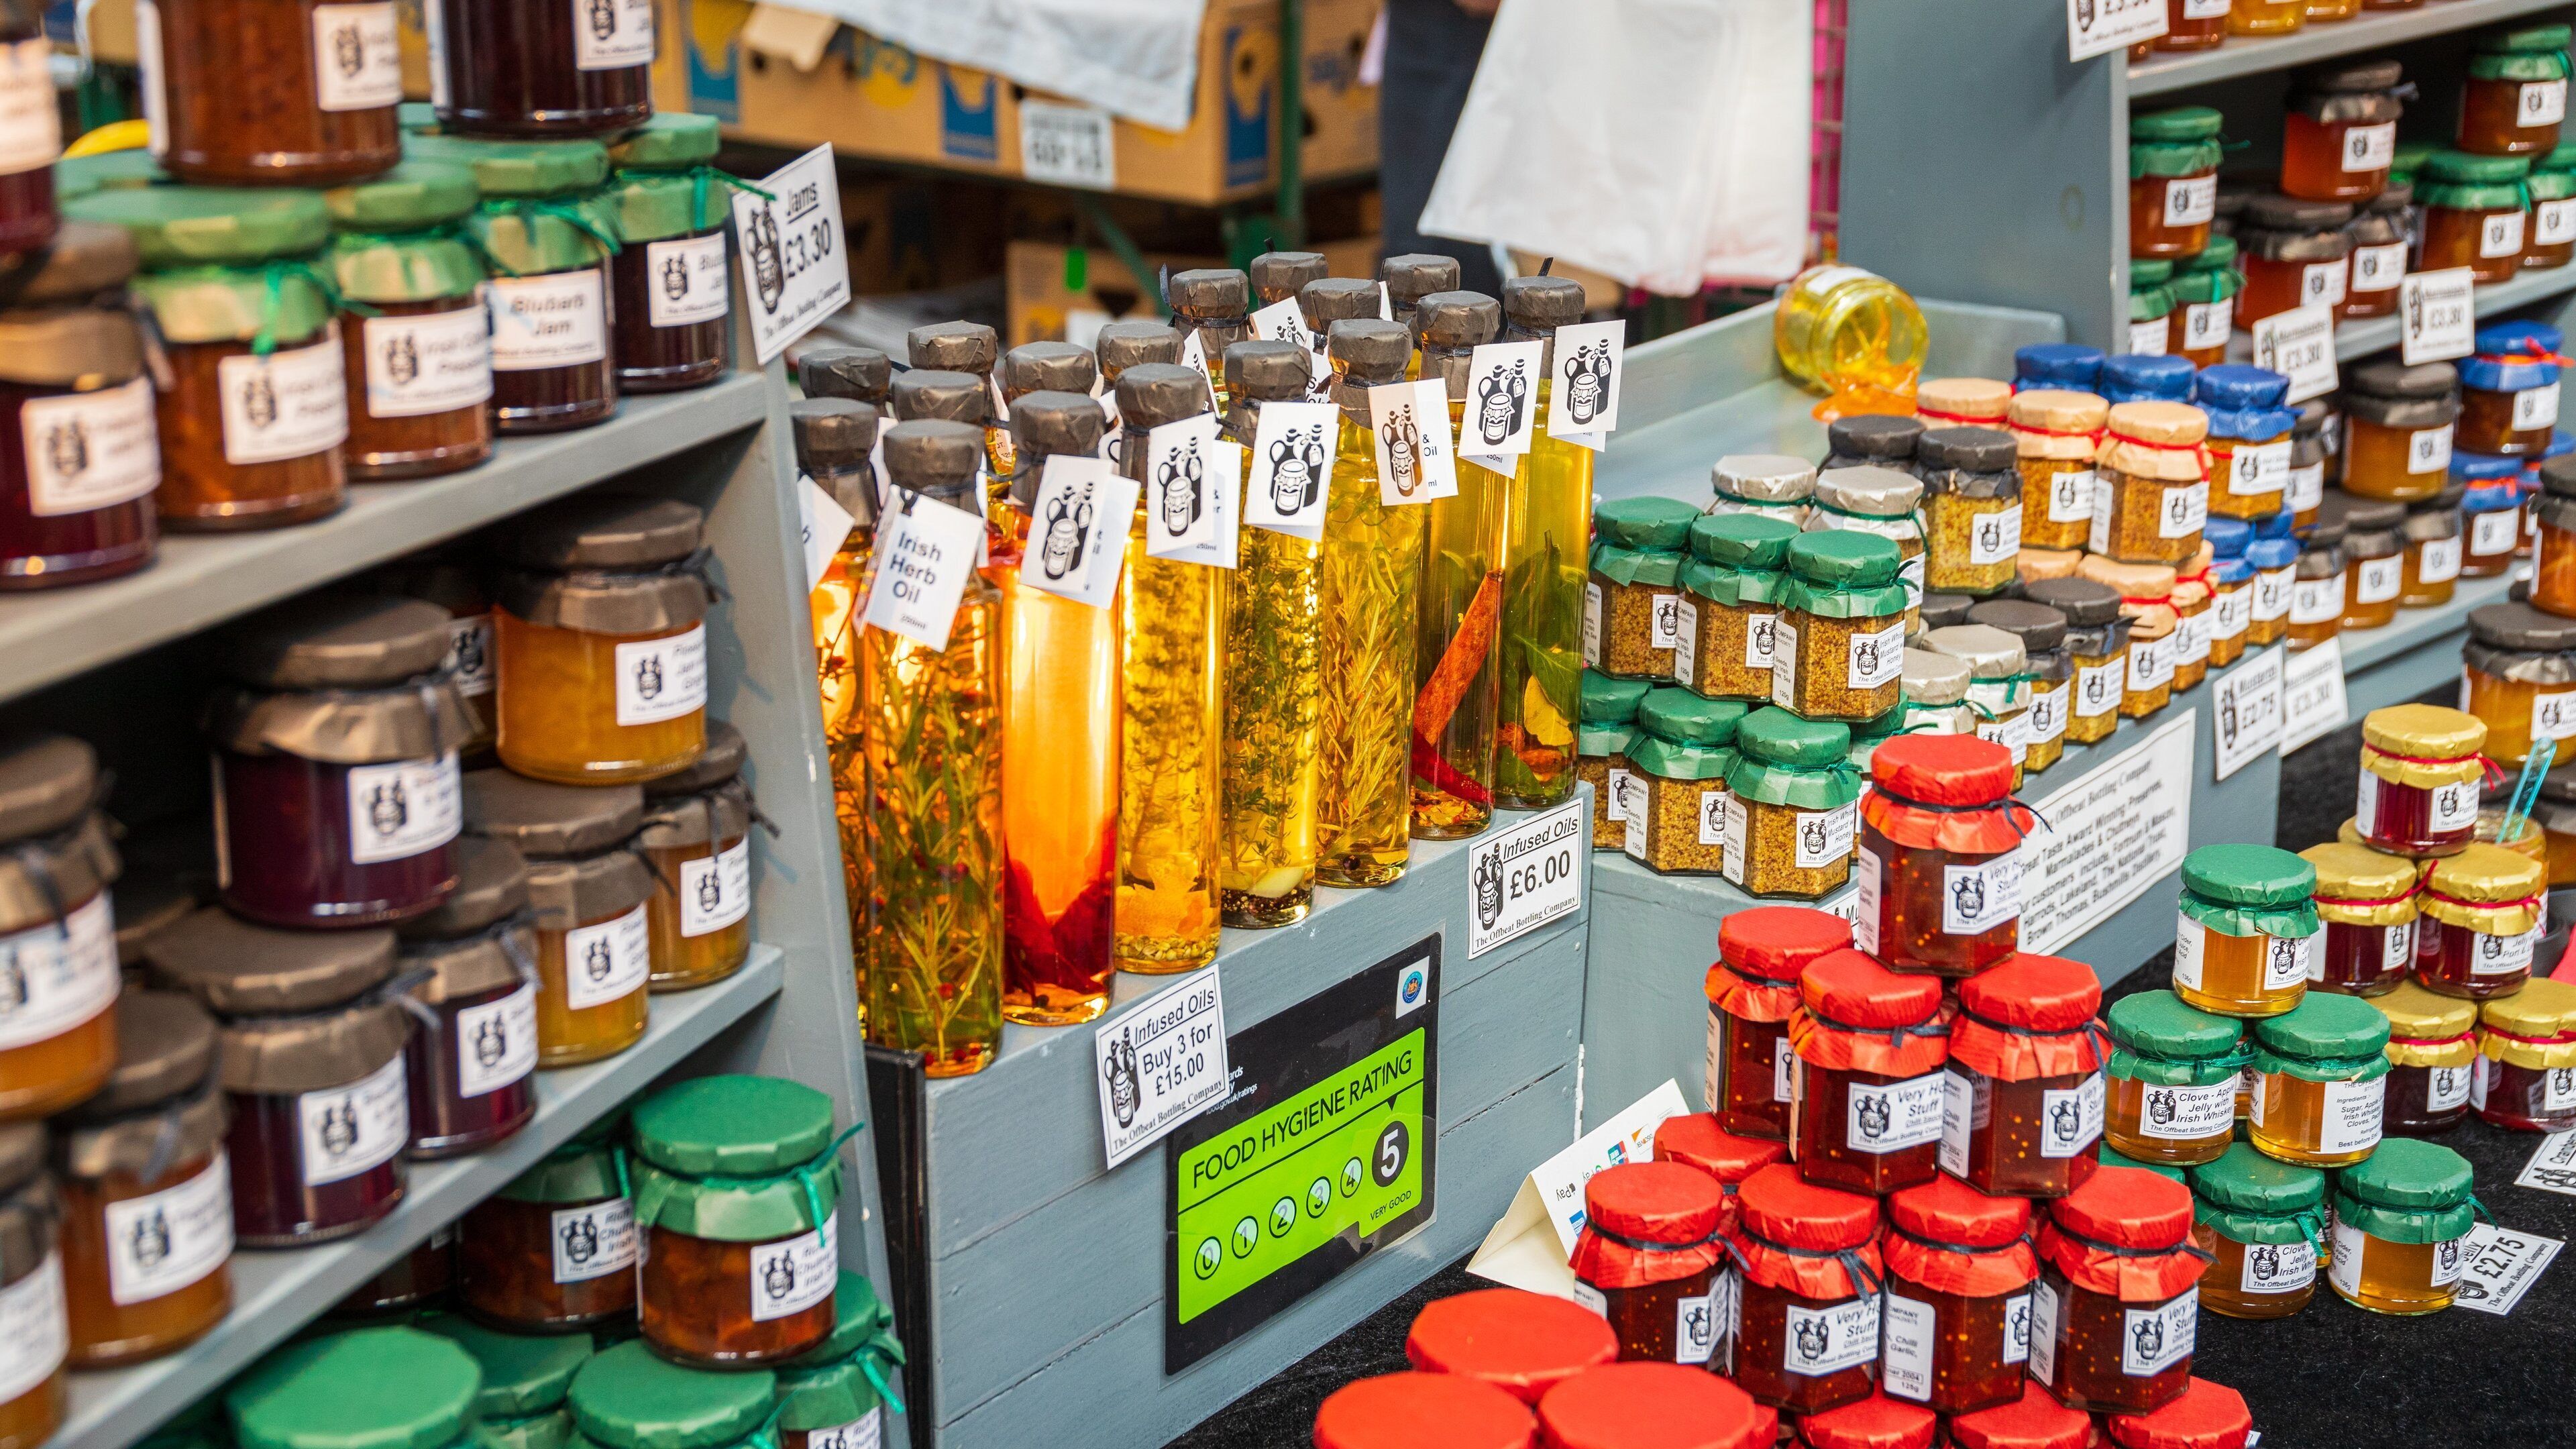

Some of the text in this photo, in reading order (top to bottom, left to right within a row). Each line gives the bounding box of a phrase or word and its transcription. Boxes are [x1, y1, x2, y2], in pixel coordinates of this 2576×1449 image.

[786, 182, 818, 217] Jams
[786, 217, 832, 279] £3.30
[533, 319, 572, 335] Jam
[1422, 433, 1430, 444] &
[897, 529, 943, 562] Irish
[889, 553, 938, 585] Herb
[892, 580, 922, 604] Oil
[1886, 653, 1902, 666] Honey
[1778, 688, 1790, 702] 120g
[1726, 805, 1746, 820] COMPANY
[1826, 816, 1839, 828] Irish
[1827, 821, 1849, 838] Mustard
[1503, 816, 1578, 860] Infused Oils
[1835, 831, 1853, 844] Honey
[2041, 838, 2063, 862] Taste
[2066, 822, 2093, 849] Award
[1631, 841, 1643, 853] 120g
[1509, 849, 1571, 902] £6.00
[1729, 867, 1740, 879] 120g
[2032, 873, 2074, 906] customers
[1475, 896, 1576, 949] The Offbeat Bottling Company
[2026, 921, 2054, 946] Brown
[2502, 947, 2520, 959] Port
[1134, 989, 1215, 1045] Infused Oils
[1142, 1022, 1214, 1075] Buy 3 for
[1156, 1052, 1205, 1097] £15.00
[2179, 1083, 2235, 1102] Clove Apple
[2344, 1081, 2357, 1089] THE
[1897, 1087, 1925, 1103] Very
[2337, 1095, 2367, 1104] Ingredients
[1908, 1098, 1939, 1117] Stuff
[2188, 1097, 2230, 1114] Jelly with
[2341, 1099, 2379, 1114] Sugar, Apple
[1113, 1079, 1224, 1150] The Offbeat Bottling Company
[1193, 1049, 1413, 1190] FOOD HYGIENE RATING
[2176, 1106, 2233, 1123] Irish Whiskey
[2343, 1112, 2360, 1121] Irish
[2190, 1125, 2213, 1133] Bottling
[2213, 1118, 2232, 1129] Company
[2338, 1137, 2371, 1148] Best before
[1201, 1247, 1214, 1271] 0
[1276, 1205, 1289, 1231] 2
[1313, 1185, 1325, 1210] 3
[1345, 1165, 1356, 1189] 4
[1380, 1127, 1401, 1178] 5
[1555, 1186, 1572, 1202] Pay
[1368, 1189, 1412, 1222] VERY GOOD
[2282, 1244, 2306, 1256] Clove
[2337, 1239, 2353, 1255] Cider,
[2290, 1253, 2309, 1266] Jelly
[2472, 1235, 2526, 1281] £2.75
[2279, 1266, 2300, 1277] Irish
[2486, 1242, 2549, 1307] The Offbeat Bottling Company
[1836, 1309, 1866, 1326] Very
[2168, 1304, 2187, 1321] Very
[1846, 1320, 1876, 1338] Stuff
